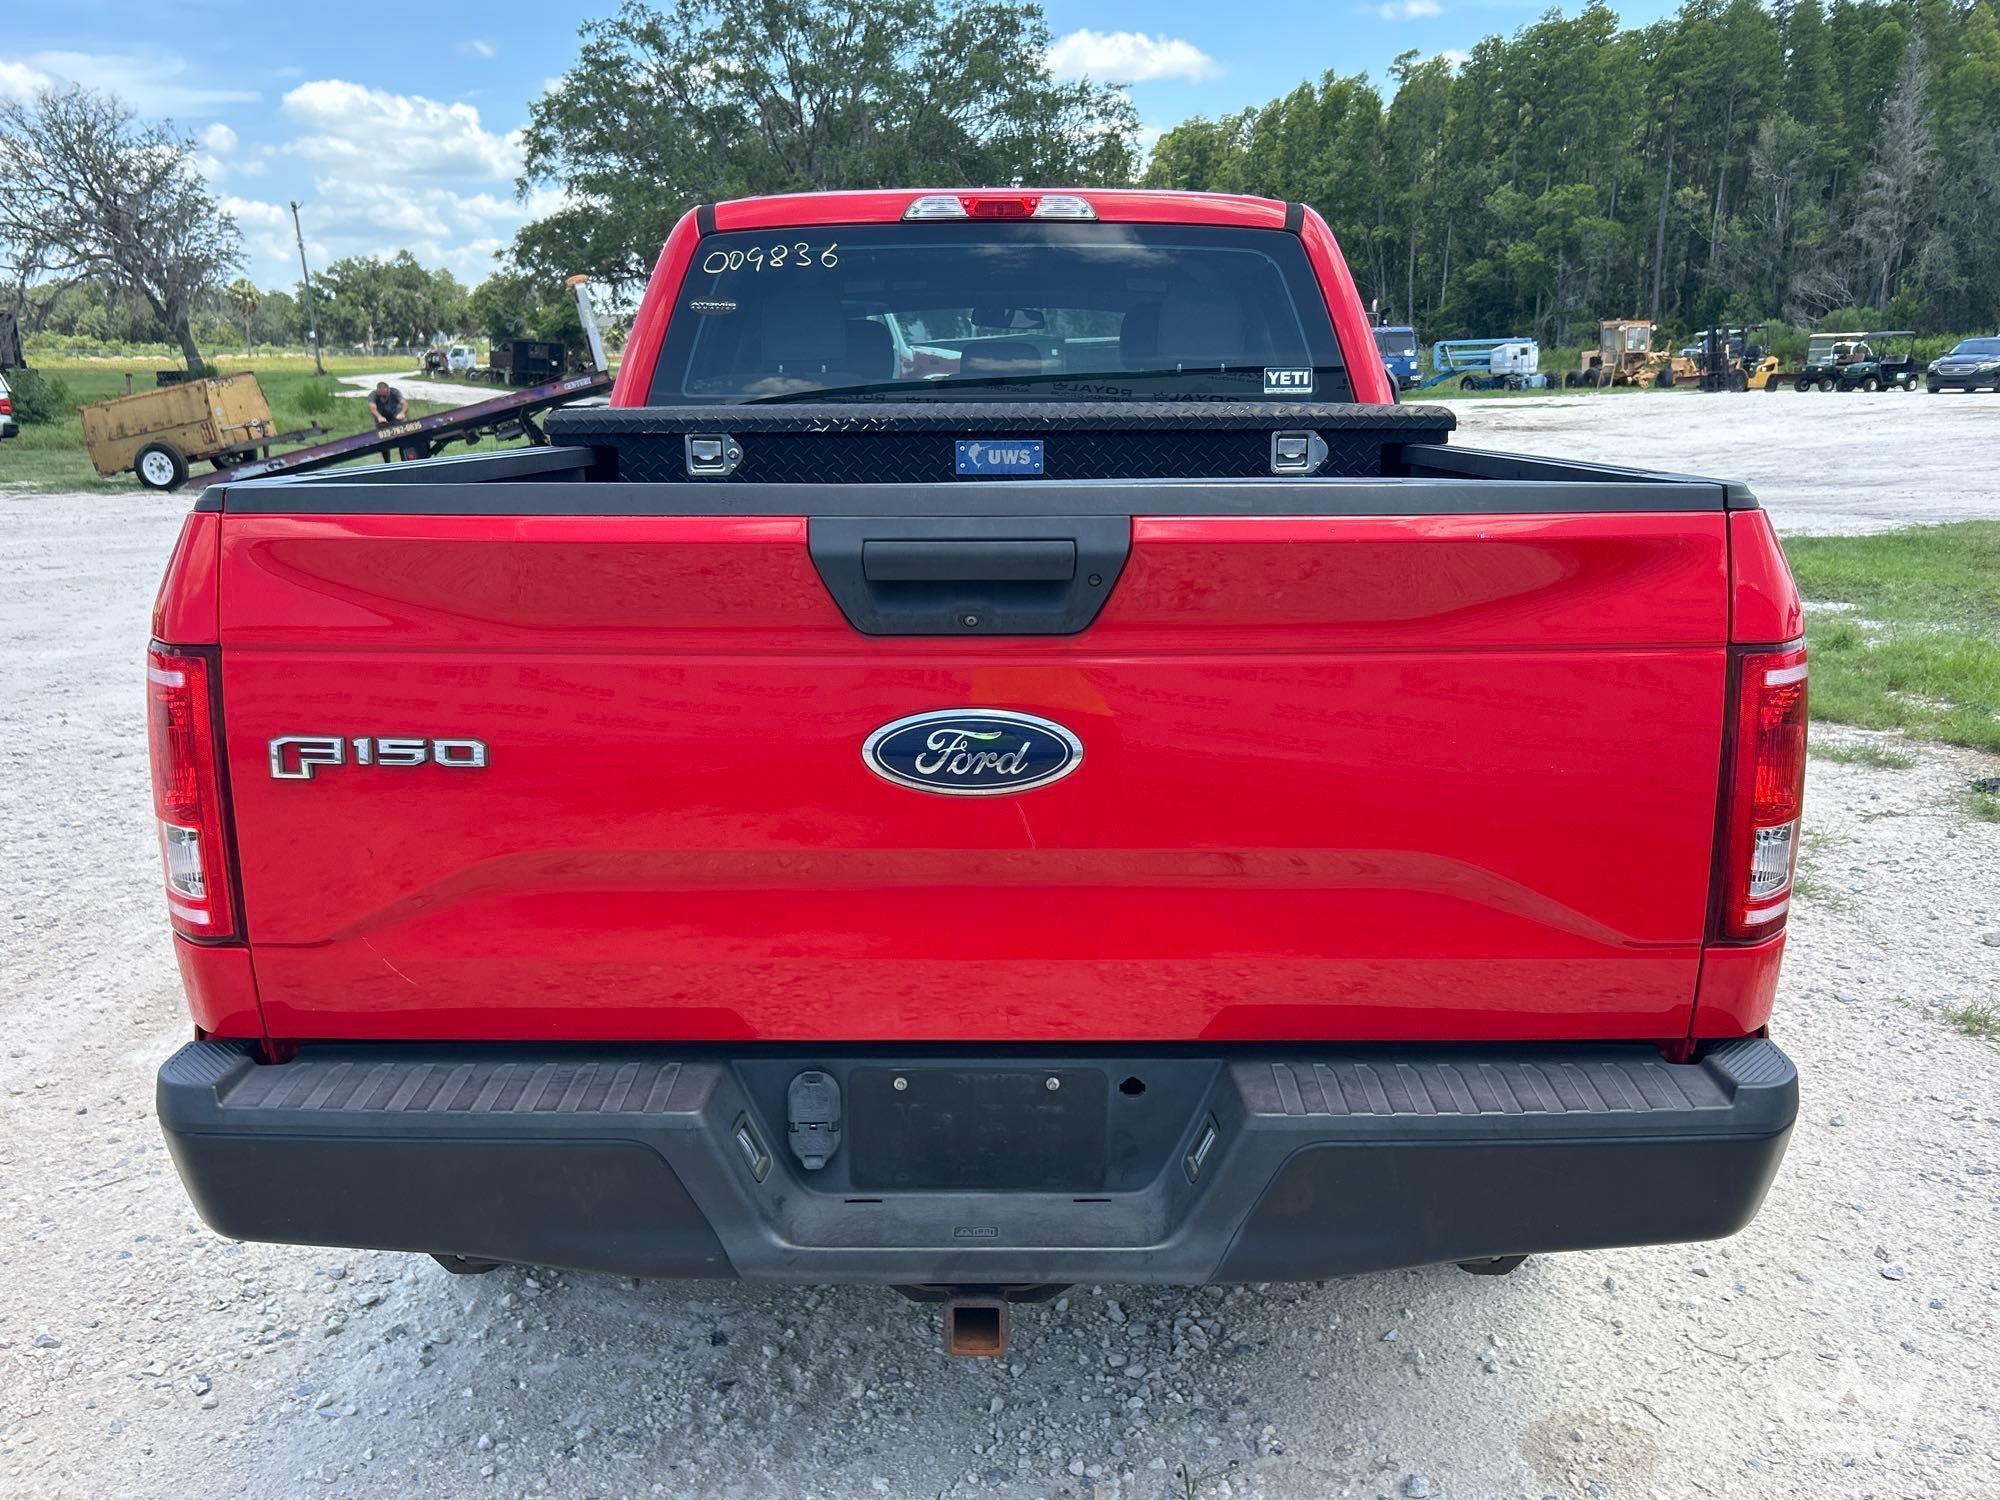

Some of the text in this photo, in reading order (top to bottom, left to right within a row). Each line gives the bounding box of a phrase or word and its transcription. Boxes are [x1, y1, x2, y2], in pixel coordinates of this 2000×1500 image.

[703, 243, 838, 274] 009836
[1266, 371, 1309, 385] YETI
[988, 449, 1031, 465] UWS
[915, 728, 1031, 775] Ford
